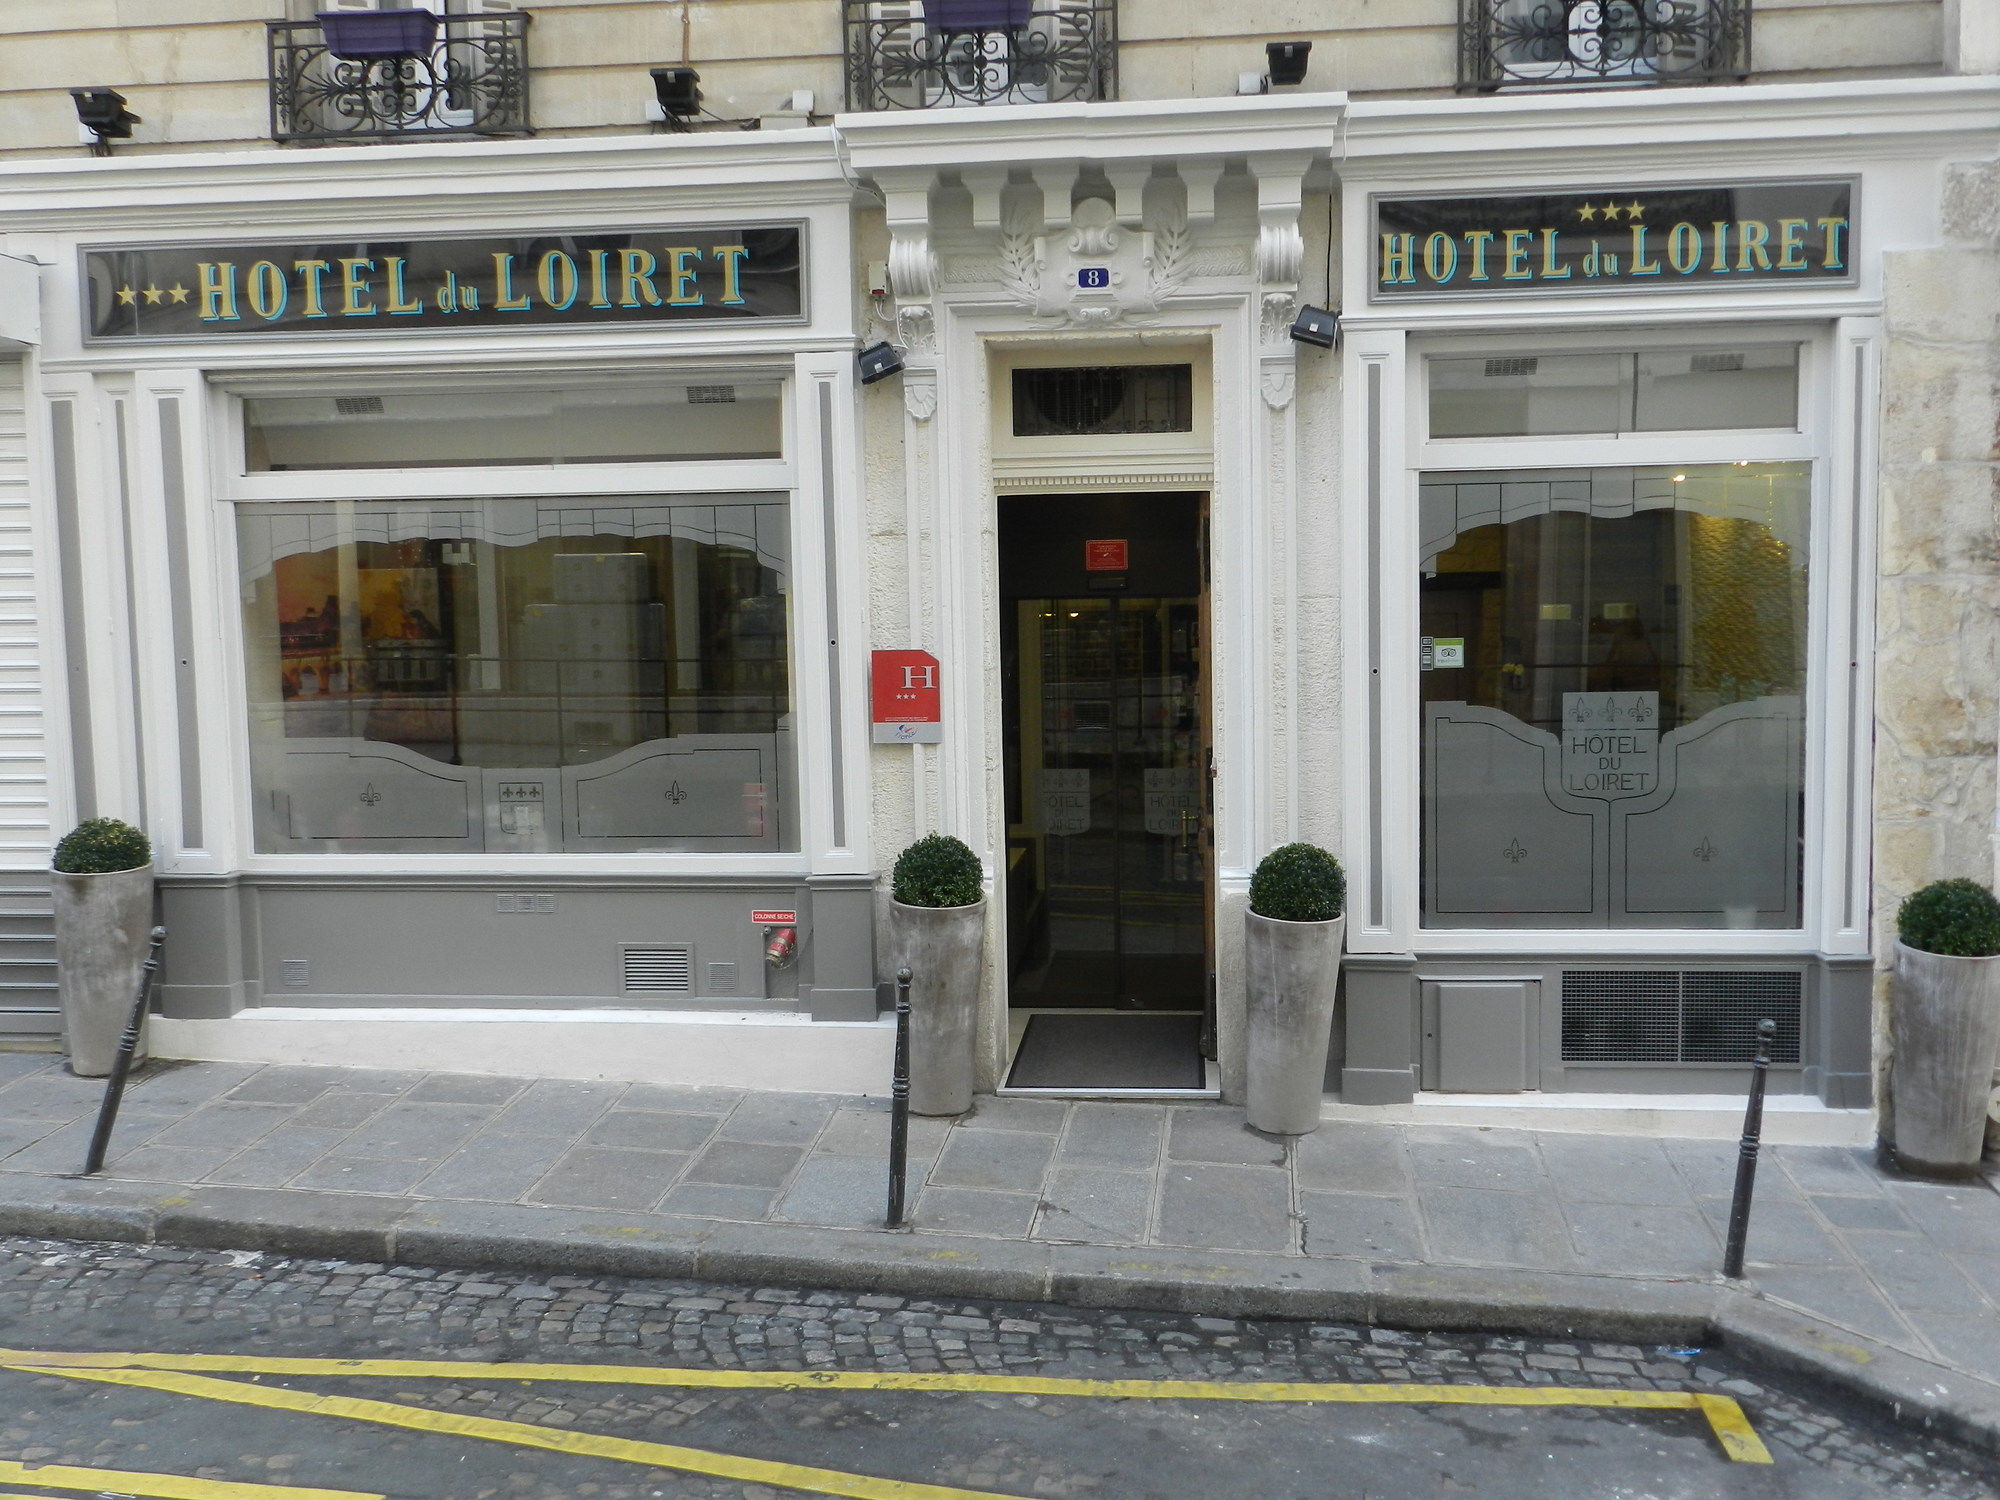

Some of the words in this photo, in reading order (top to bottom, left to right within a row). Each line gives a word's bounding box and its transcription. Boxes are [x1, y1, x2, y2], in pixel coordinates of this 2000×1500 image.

[1381, 225, 1571, 285] HOTEL
[1583, 239, 1619, 278] du
[1630, 216, 1849, 276] LOIRET
[197, 256, 423, 321] HOTEL
[437, 270, 479, 313] du
[491, 245, 749, 311] LOIRET
[1087, 270, 1100, 286] 8
[901, 665, 937, 689] H
[1599, 757, 1621, 770] DU
[1569, 773, 1650, 791] LOIRET
